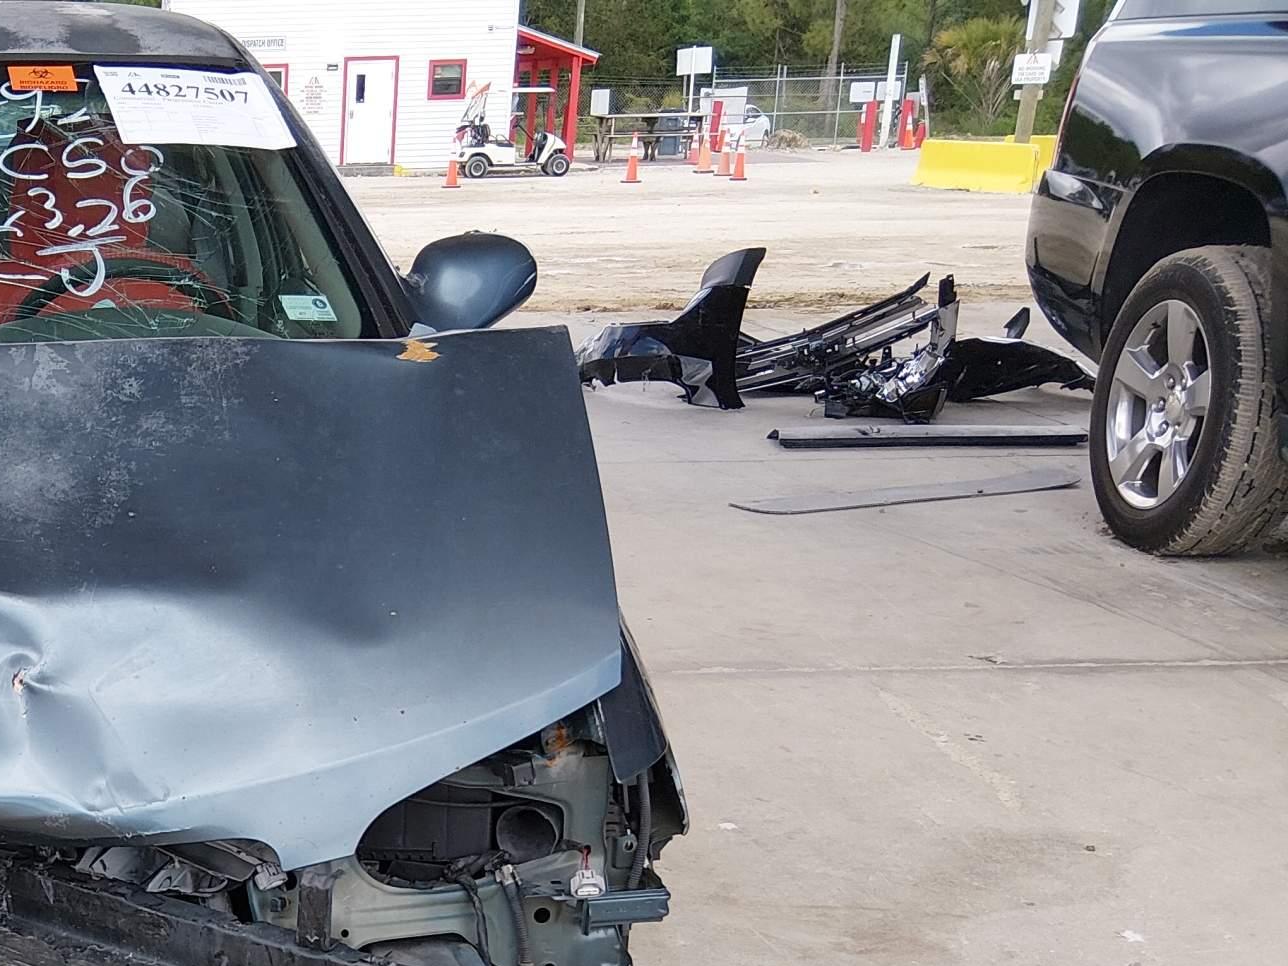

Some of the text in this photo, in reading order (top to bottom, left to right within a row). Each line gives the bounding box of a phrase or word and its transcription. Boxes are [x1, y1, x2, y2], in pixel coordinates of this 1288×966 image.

[242, 39, 284, 48] DISPATCH OFFICE
[121, 82, 248, 104] 44827507
